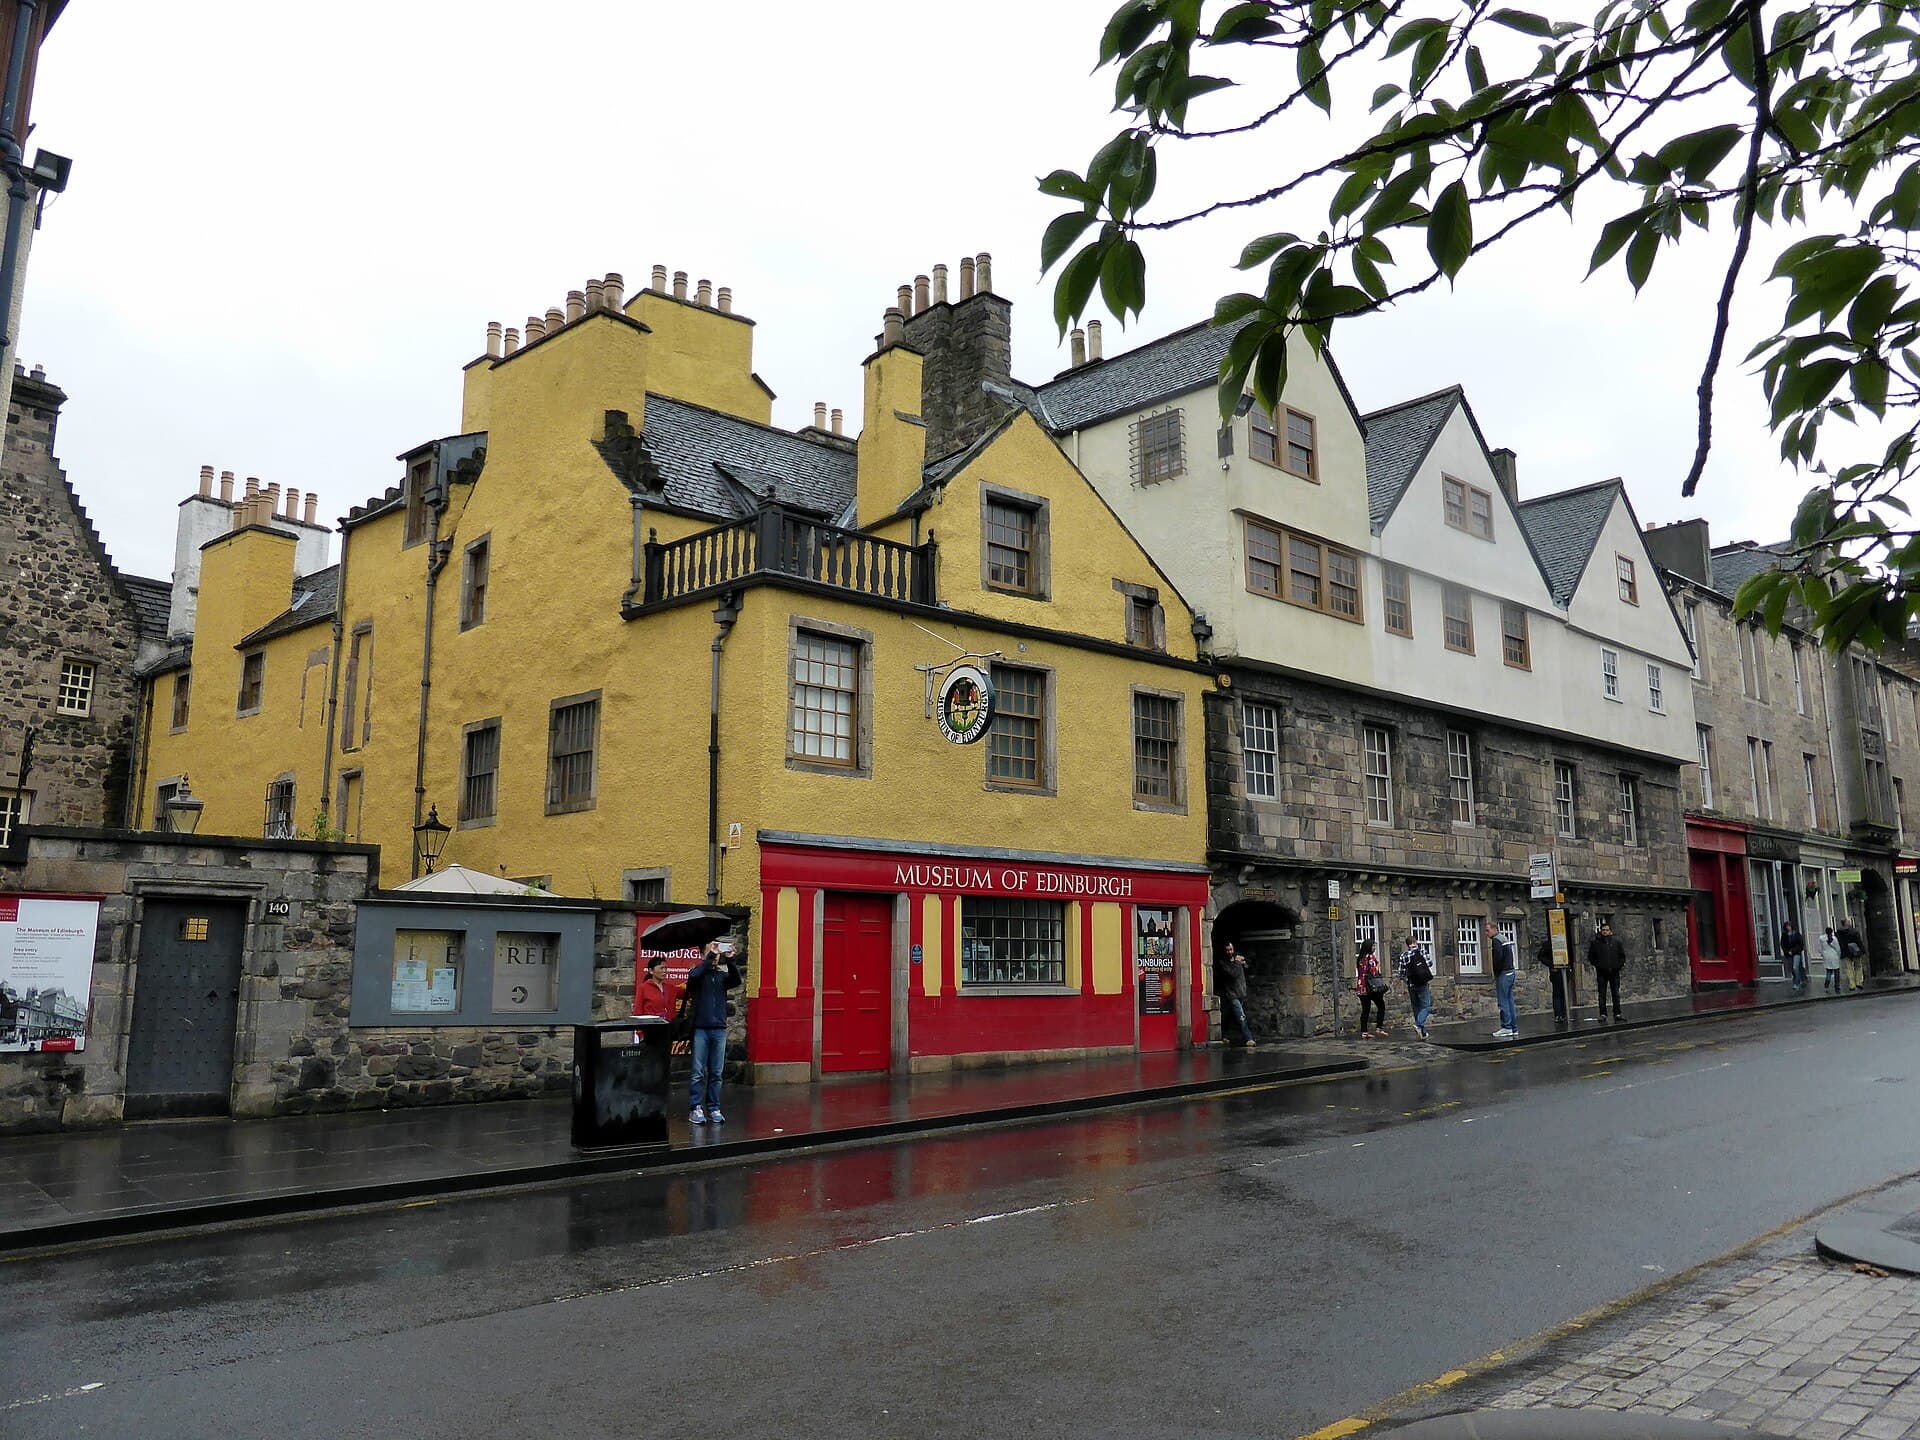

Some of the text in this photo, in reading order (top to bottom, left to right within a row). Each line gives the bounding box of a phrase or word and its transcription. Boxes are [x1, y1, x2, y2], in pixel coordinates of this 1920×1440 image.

[938, 696, 951, 736] MUSEUM
[962, 690, 987, 742] EDINBURGH
[894, 864, 1132, 896] MUSEUM OF EDINBURGH
[268, 902, 289, 914] 140
